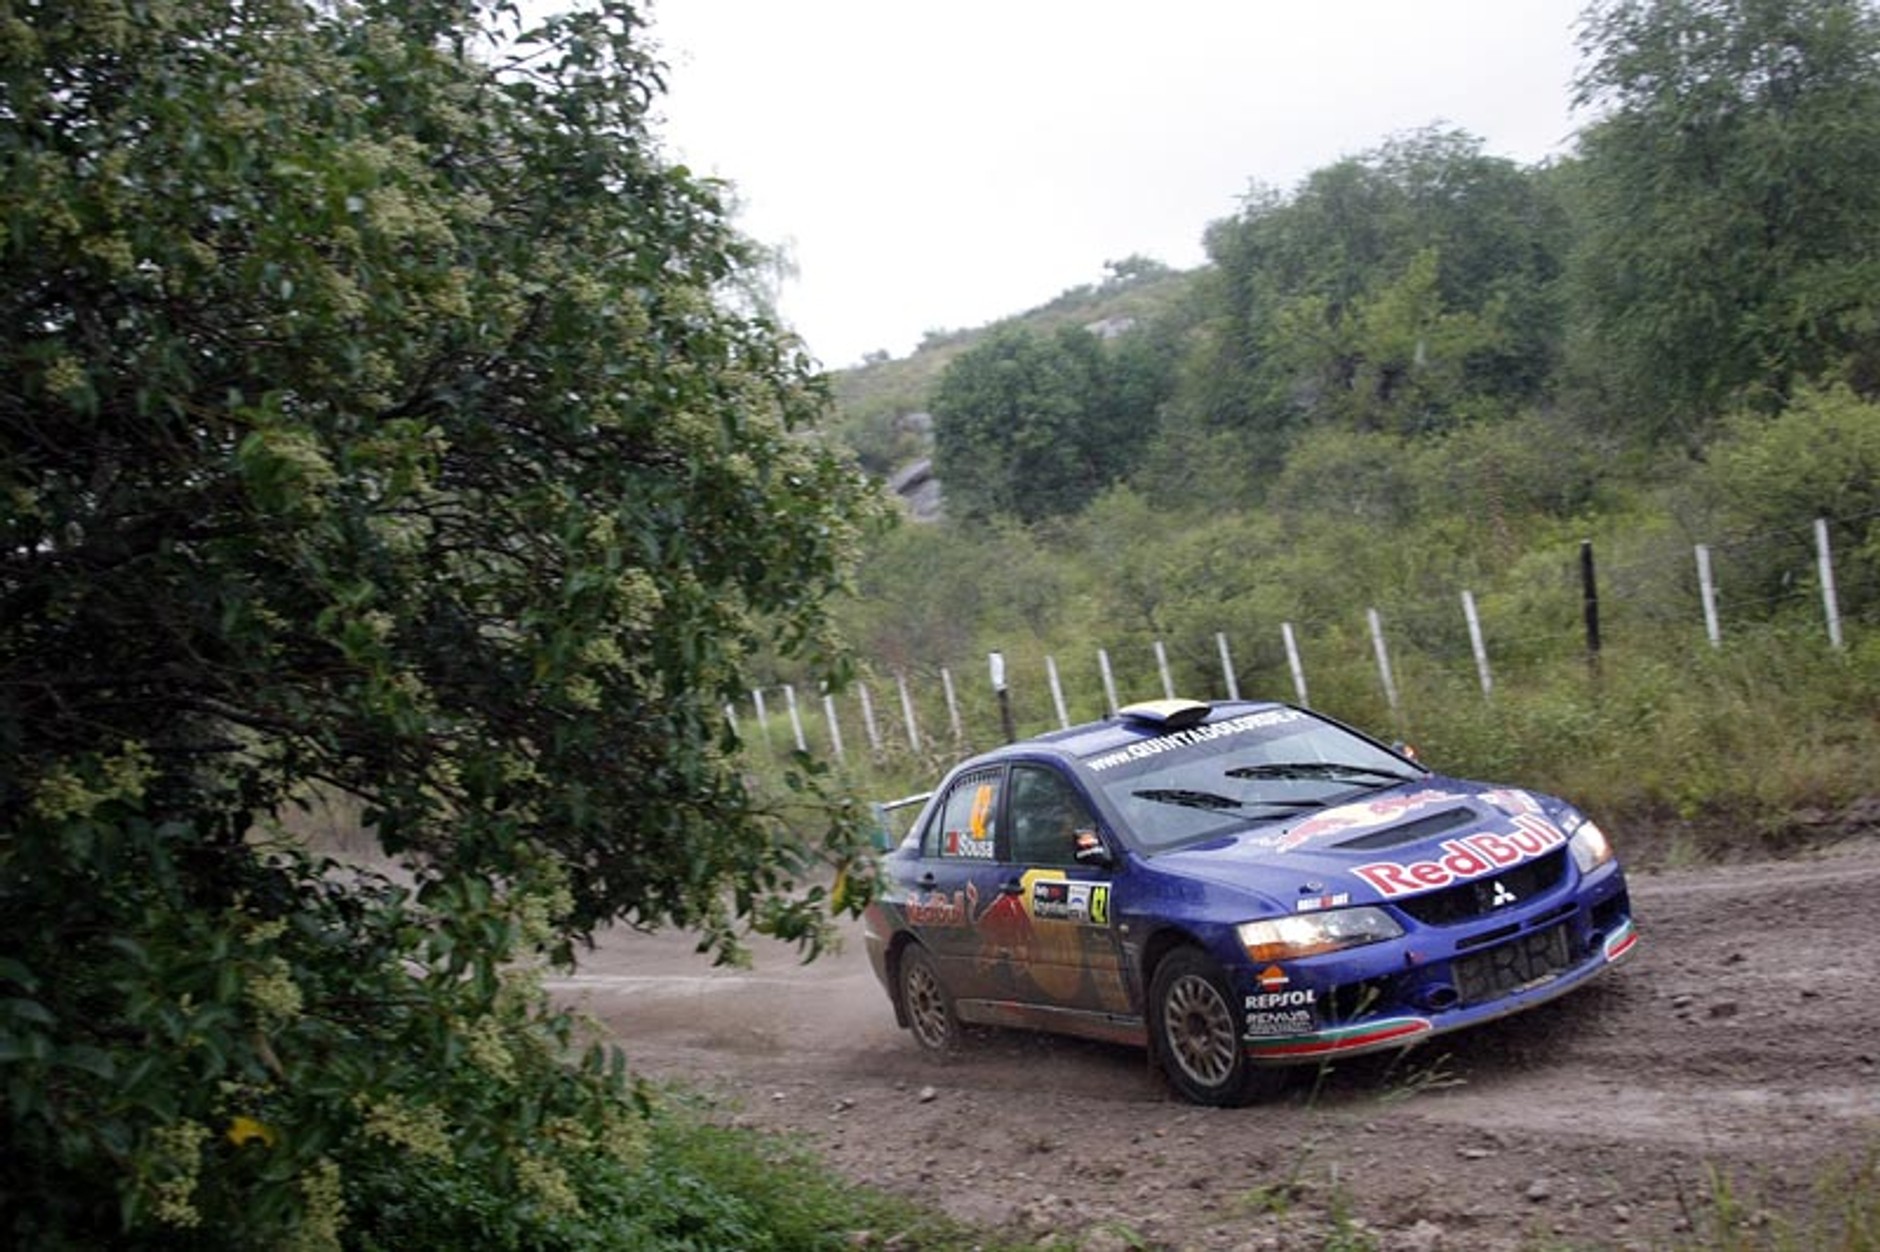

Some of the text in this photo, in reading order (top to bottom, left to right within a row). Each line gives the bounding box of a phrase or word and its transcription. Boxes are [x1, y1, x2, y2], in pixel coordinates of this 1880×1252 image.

[959, 831, 994, 858] Sousa
[1354, 812, 1564, 897] Red Bull
[1245, 988, 1317, 1010] REPSOL
